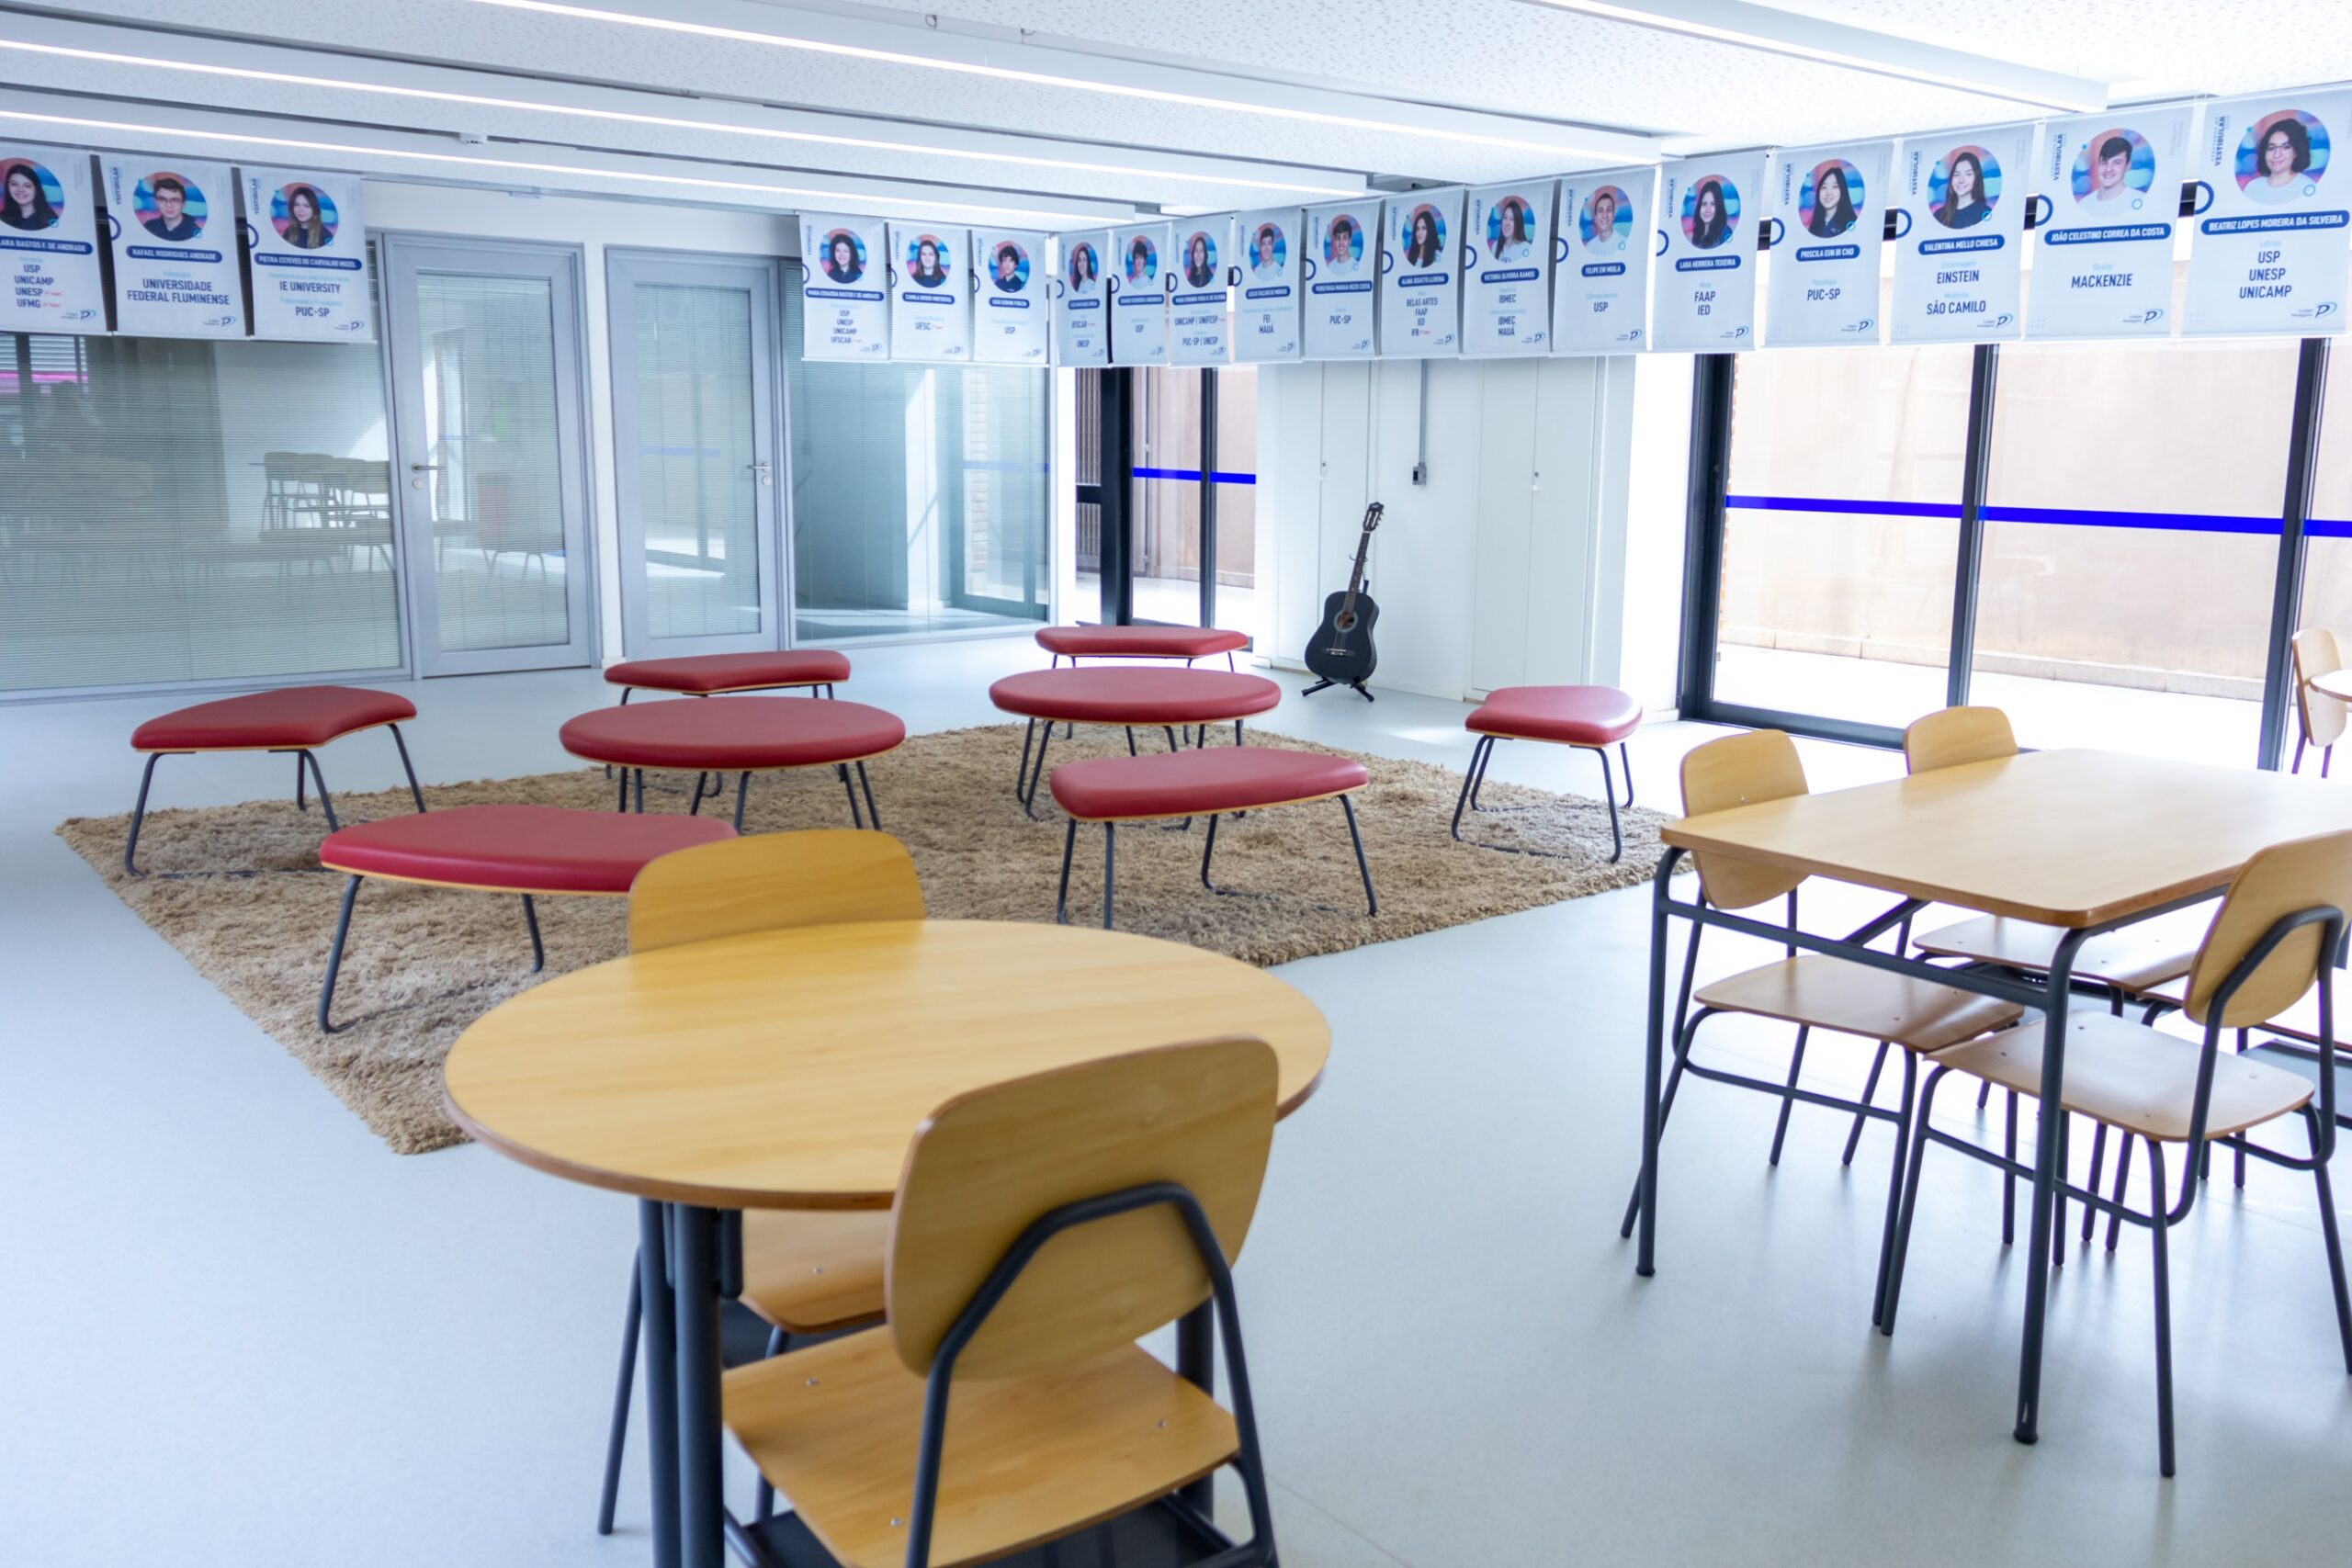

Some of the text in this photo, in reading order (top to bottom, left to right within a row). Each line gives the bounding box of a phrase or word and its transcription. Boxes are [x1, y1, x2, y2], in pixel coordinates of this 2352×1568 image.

[2214, 116, 2224, 167] VESTIBULAR
[2053, 134, 2063, 181] VESTIBULAR
[2209, 214, 2343, 231] BEATRIZ LOPES MOREIRA DA SILVEIRA
[2051, 227, 2165, 242] JOÃO CELESTINO CORREA DA COSTA
[0, 238, 16, 246] ARA
[1924, 241, 1955, 252] VALENTINA
[1955, 239, 1974, 249] MELLO
[131, 248, 155, 257] RAFAEL
[1801, 249, 1824, 258] PRISCILA
[2257, 250, 2280, 264] USP
[258, 255, 278, 264] PIETRA
[23, 264, 40, 273] USP
[2248, 267, 2286, 281] UNESP
[14, 276, 54, 286] UNICAMP
[1937, 269, 1980, 284] EINSTEIN
[2071, 273, 2133, 288] MACKENZIE
[142, 278, 212, 291] UNIVERSIDADE
[279, 280, 341, 293] IE UNIVERSITY
[15, 287, 43, 297] UNESP
[127, 290, 230, 305] FEDERAL FLUMINENSE
[1694, 290, 1716, 302] FAAP
[1807, 288, 1841, 301] PUC-SP
[2239, 285, 2292, 299] UNICAMP
[17, 299, 41, 308] UFMG
[1406, 297, 1438, 307] BELAS ARTES
[1498, 294, 1516, 303] IBMEC
[295, 306, 330, 317] PUC-SP
[1415, 307, 1428, 316] FAAP
[1593, 301, 1609, 312] USP
[1697, 304, 1711, 315] IED
[1927, 299, 1986, 315] SÃO CAMILO
[1329, 315, 1351, 324] PUC-SP
[1498, 316, 1516, 325] IBMEC
[915, 321, 931, 331] UFSC
[1004, 325, 1016, 334] USP
[1498, 324, 1515, 336] MAUÁ
